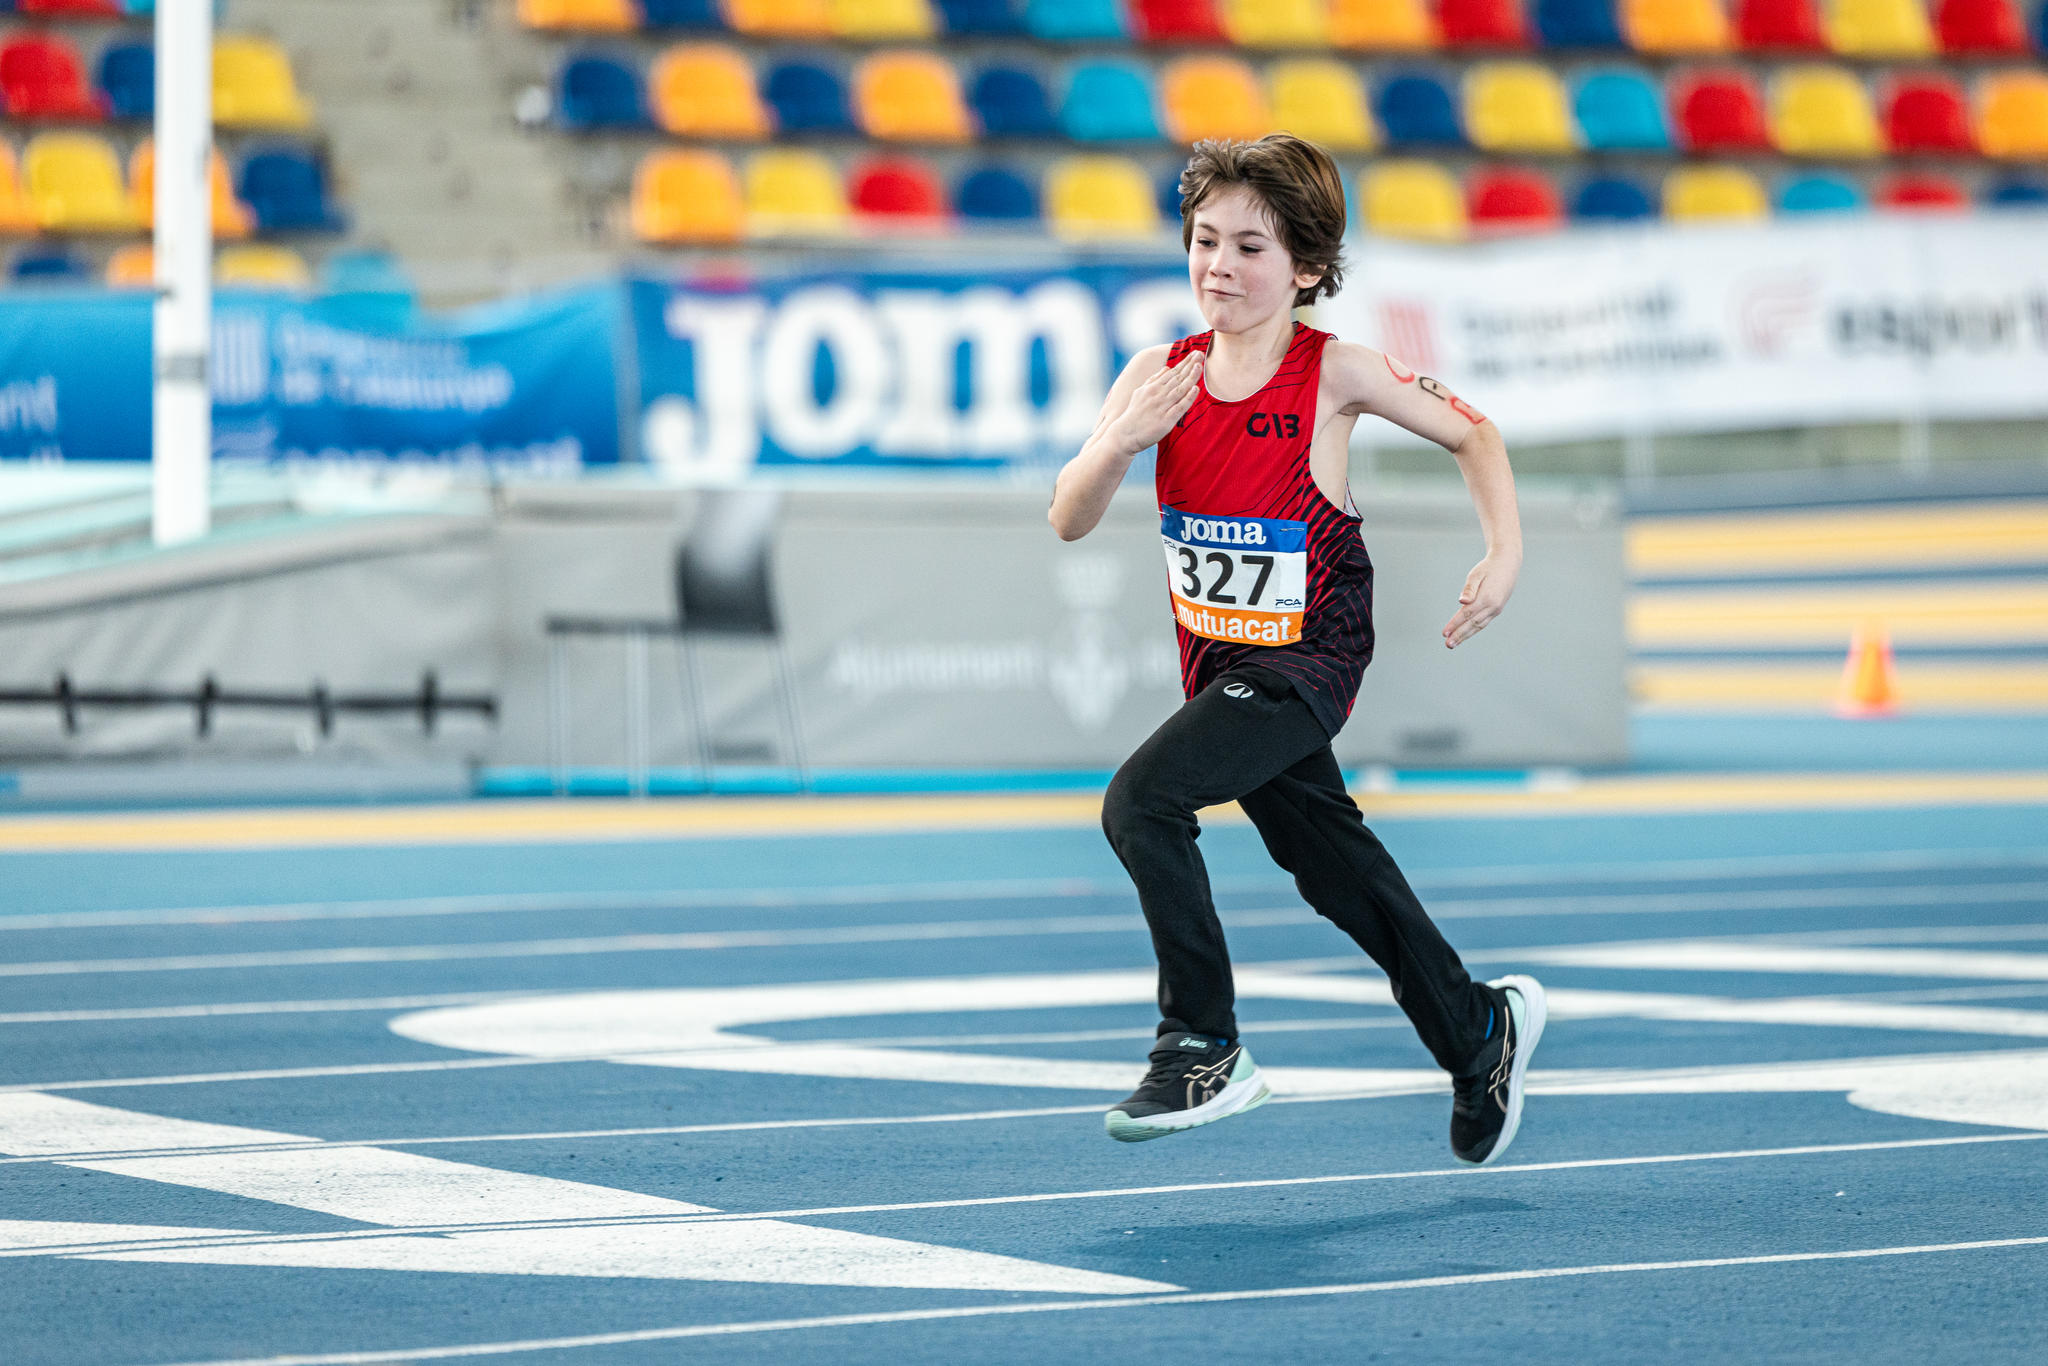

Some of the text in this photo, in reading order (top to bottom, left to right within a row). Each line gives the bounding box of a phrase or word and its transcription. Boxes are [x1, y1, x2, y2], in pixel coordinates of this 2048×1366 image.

[1180, 516, 1267, 545] Joma
[1178, 547, 1274, 606] 327
[1177, 603, 1291, 642] mutuacat
